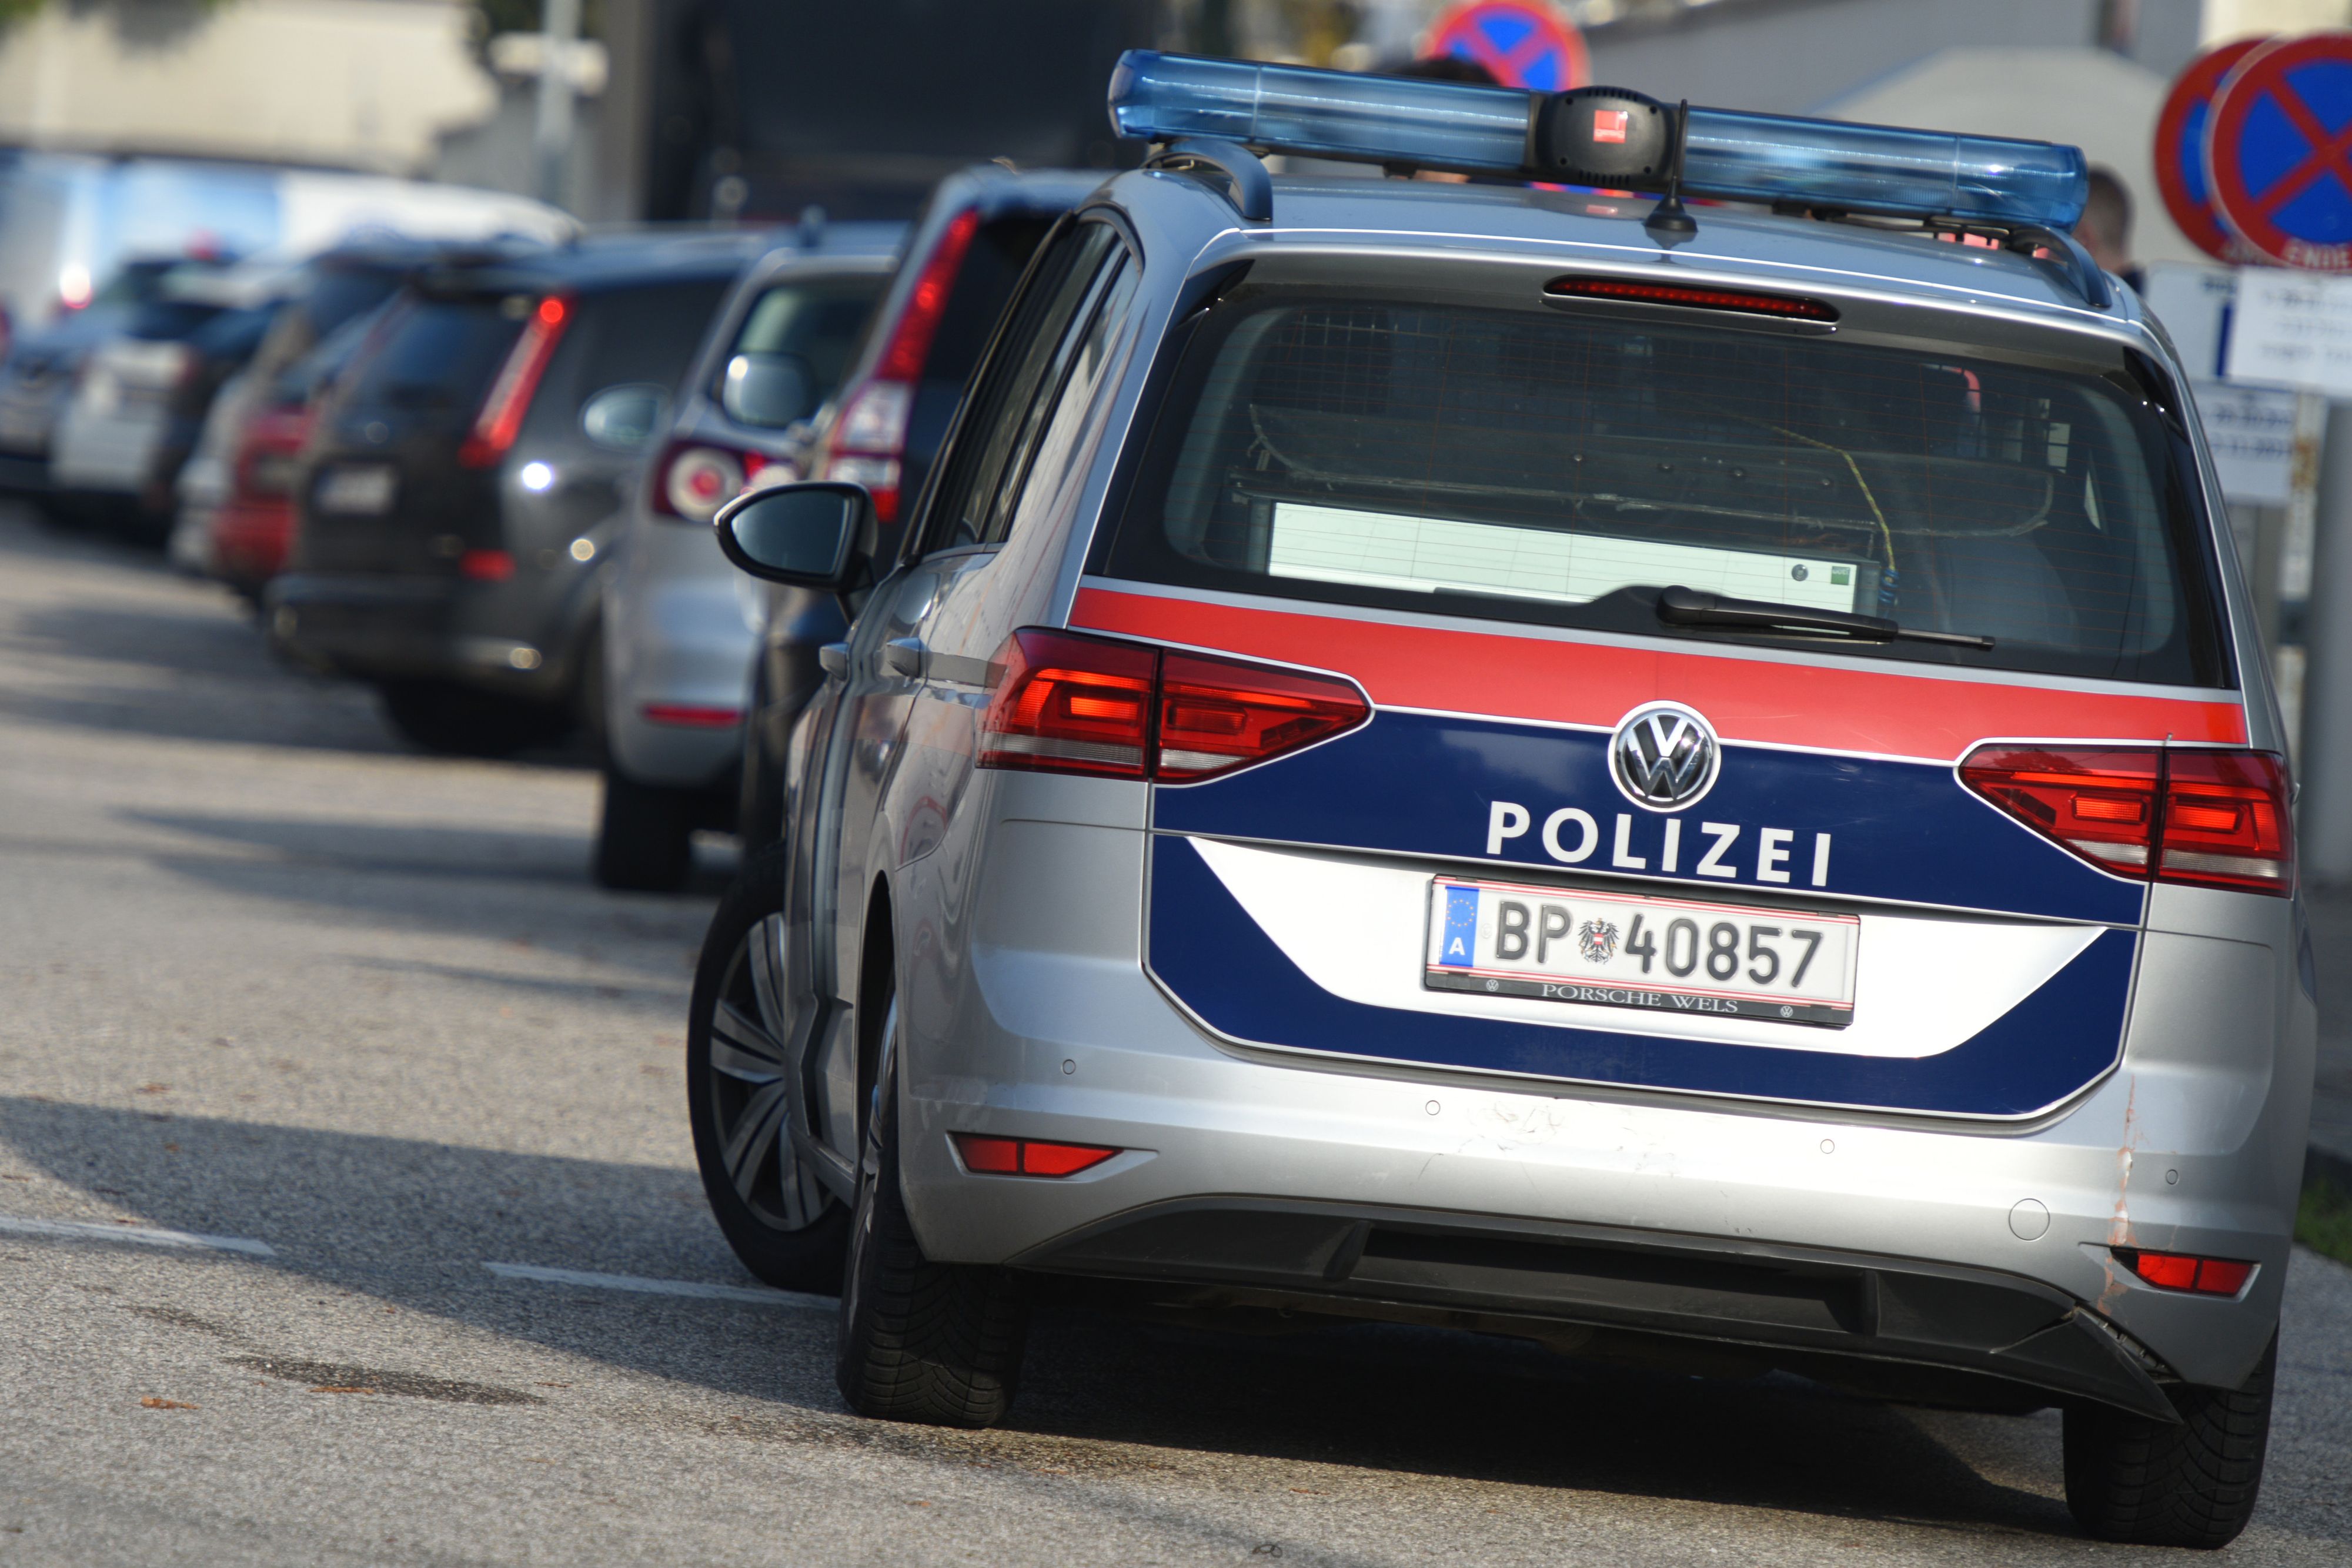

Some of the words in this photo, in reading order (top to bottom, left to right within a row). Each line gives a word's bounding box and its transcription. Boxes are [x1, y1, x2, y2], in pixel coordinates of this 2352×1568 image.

[1486, 801, 1831, 887] POLIZEI
[1448, 937, 1466, 956] A
[1496, 901, 1573, 964] BP
[1625, 913, 1825, 988] 40857
[1541, 984, 1662, 1007] PORSCHE
[1671, 995, 1739, 1014] WELS
